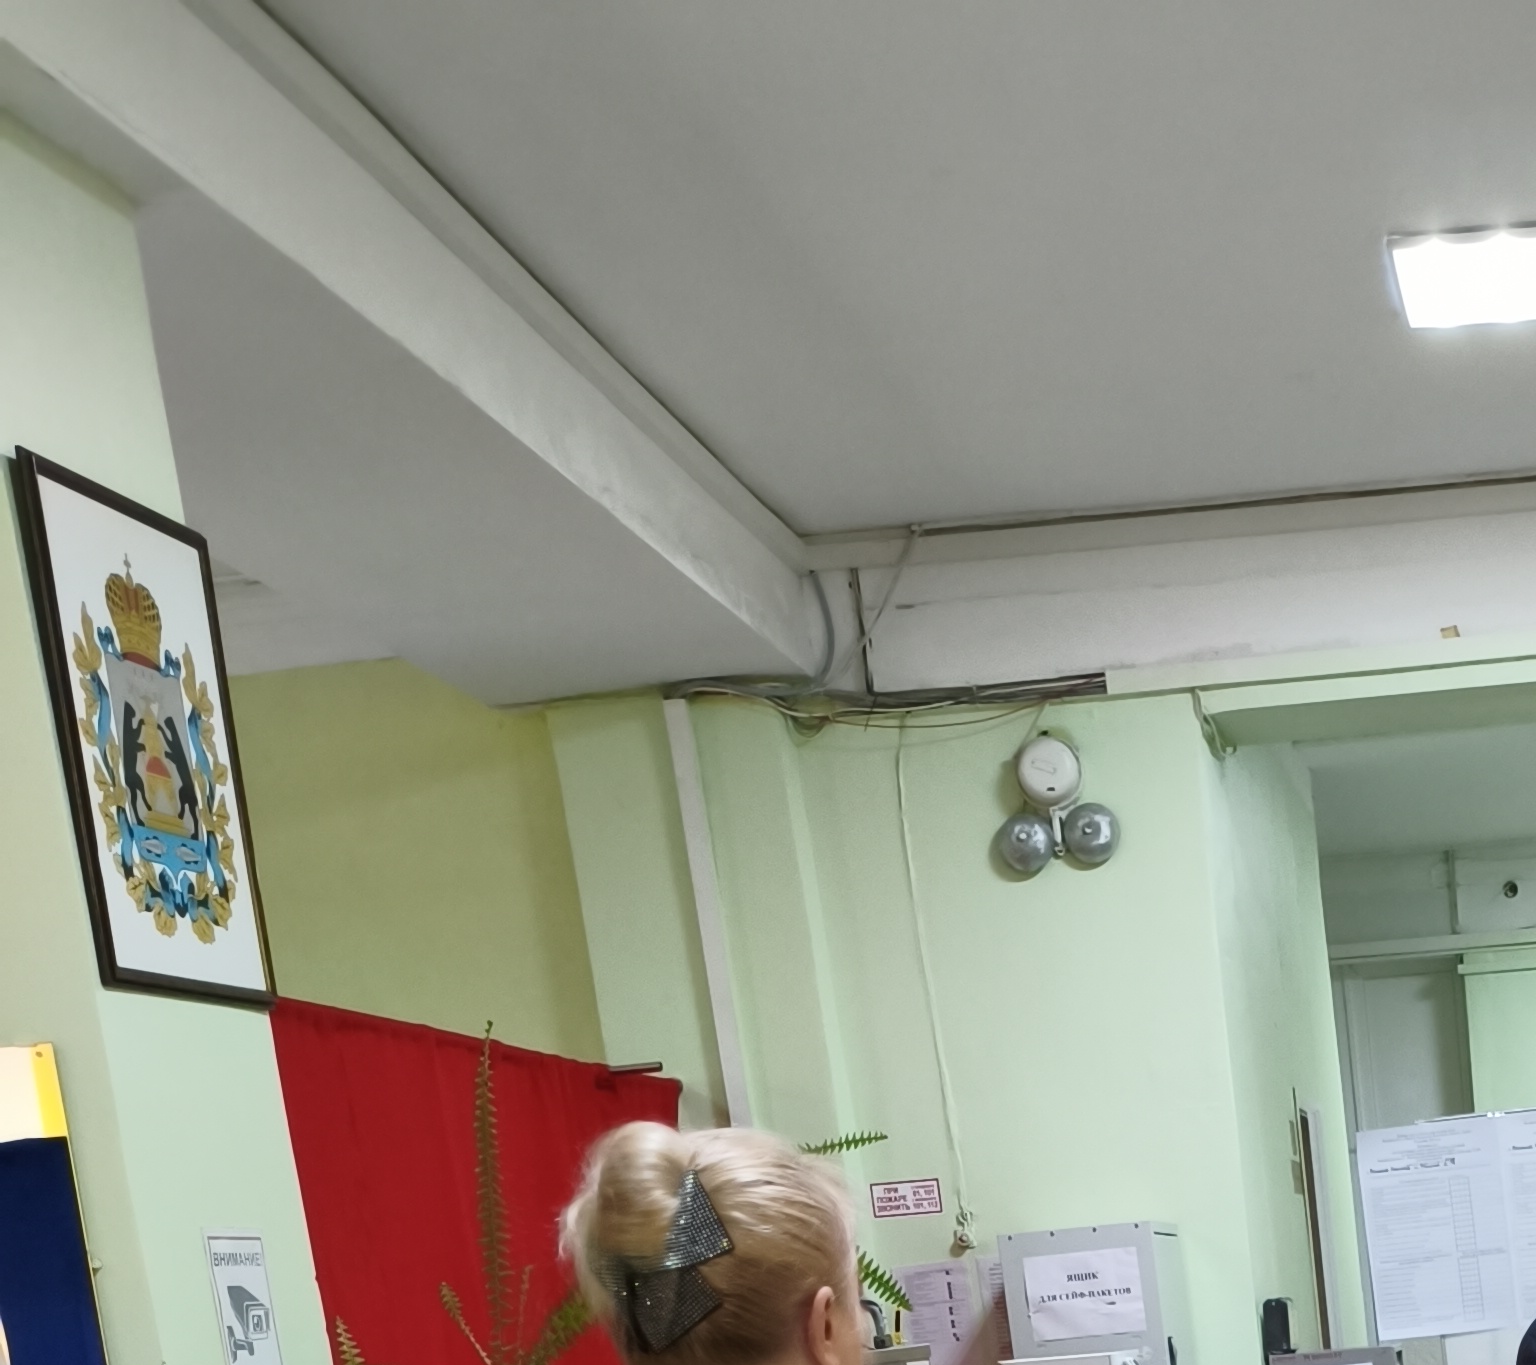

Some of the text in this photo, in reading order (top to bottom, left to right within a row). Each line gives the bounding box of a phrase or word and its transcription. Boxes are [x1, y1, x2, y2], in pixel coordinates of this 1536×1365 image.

[1066, 1271, 1099, 1282] ЯЩИК
[1038, 1287, 1132, 1305] ДЛЯ СЕЙФ-ПАКЕТОВ
